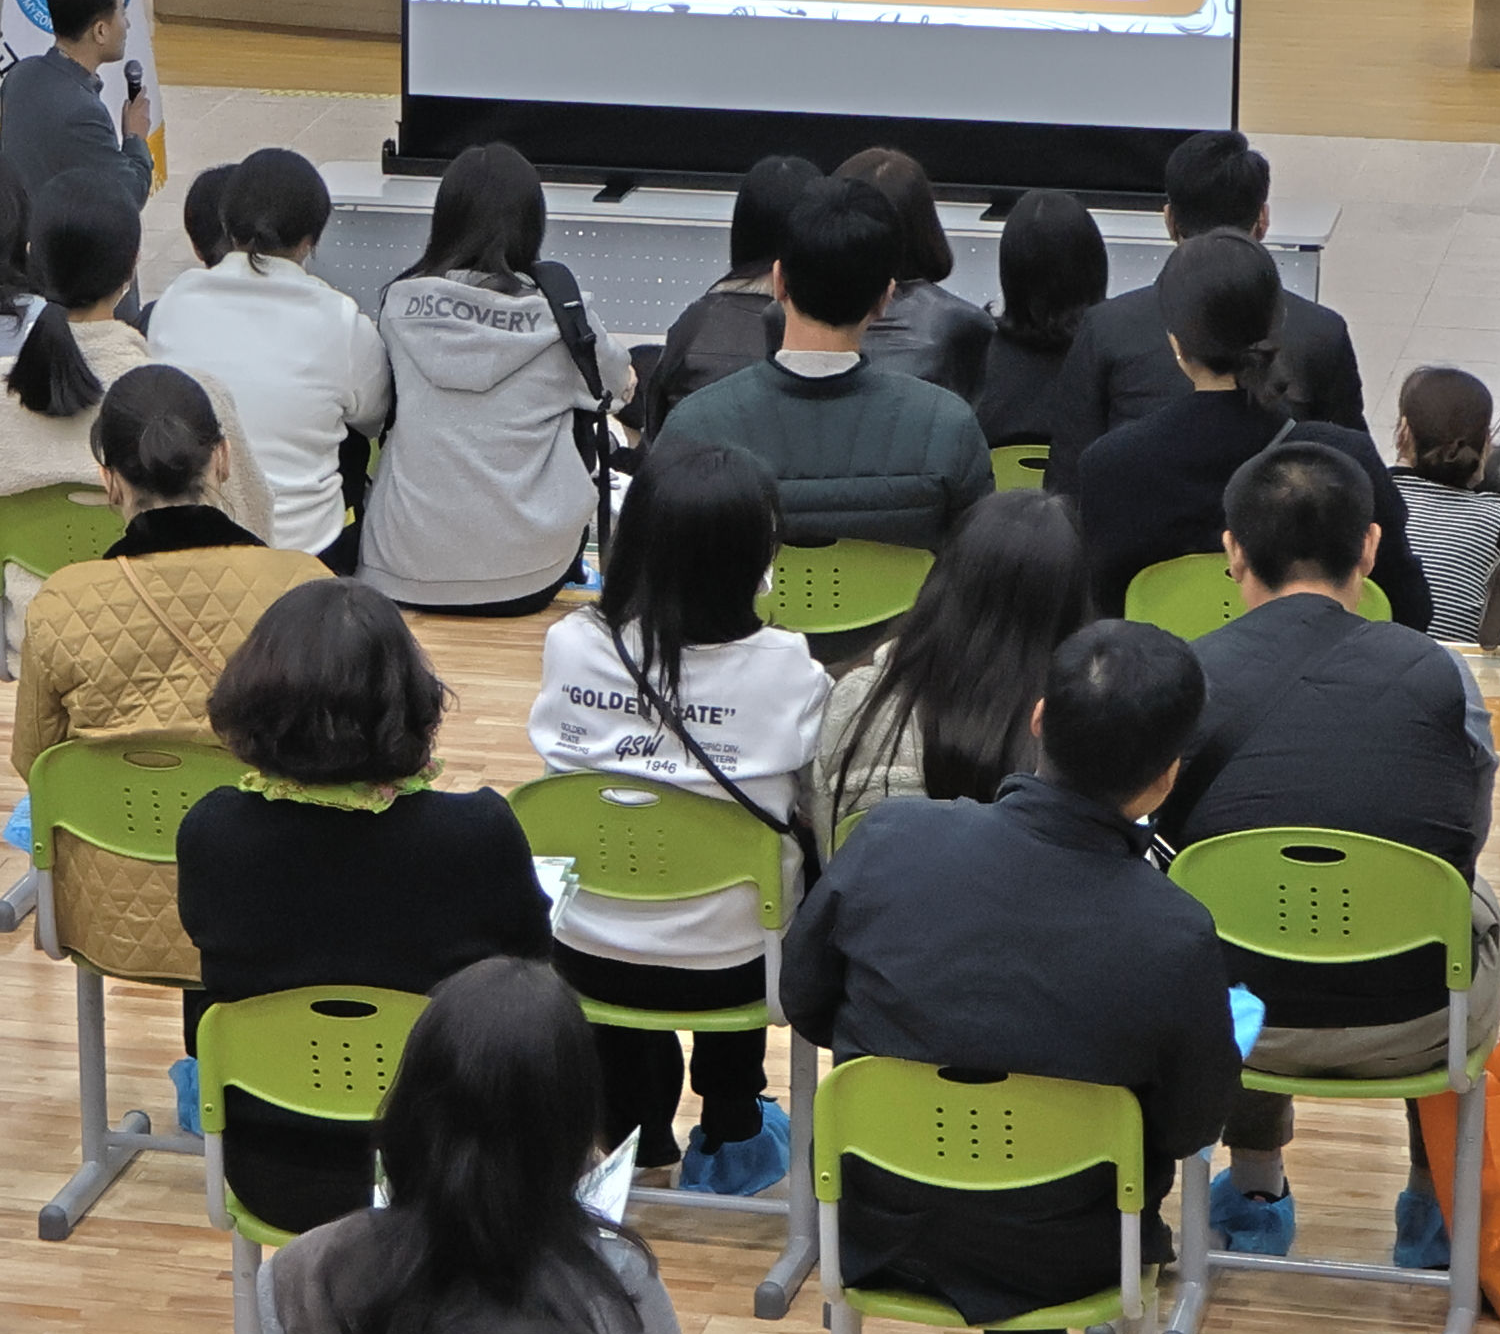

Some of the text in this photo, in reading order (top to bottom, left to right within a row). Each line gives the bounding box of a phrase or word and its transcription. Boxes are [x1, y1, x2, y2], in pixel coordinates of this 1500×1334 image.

[404, 294, 542, 333] DISCOVERY
[615, 734, 665, 762] GSW
[645, 759, 678, 774] 1946
